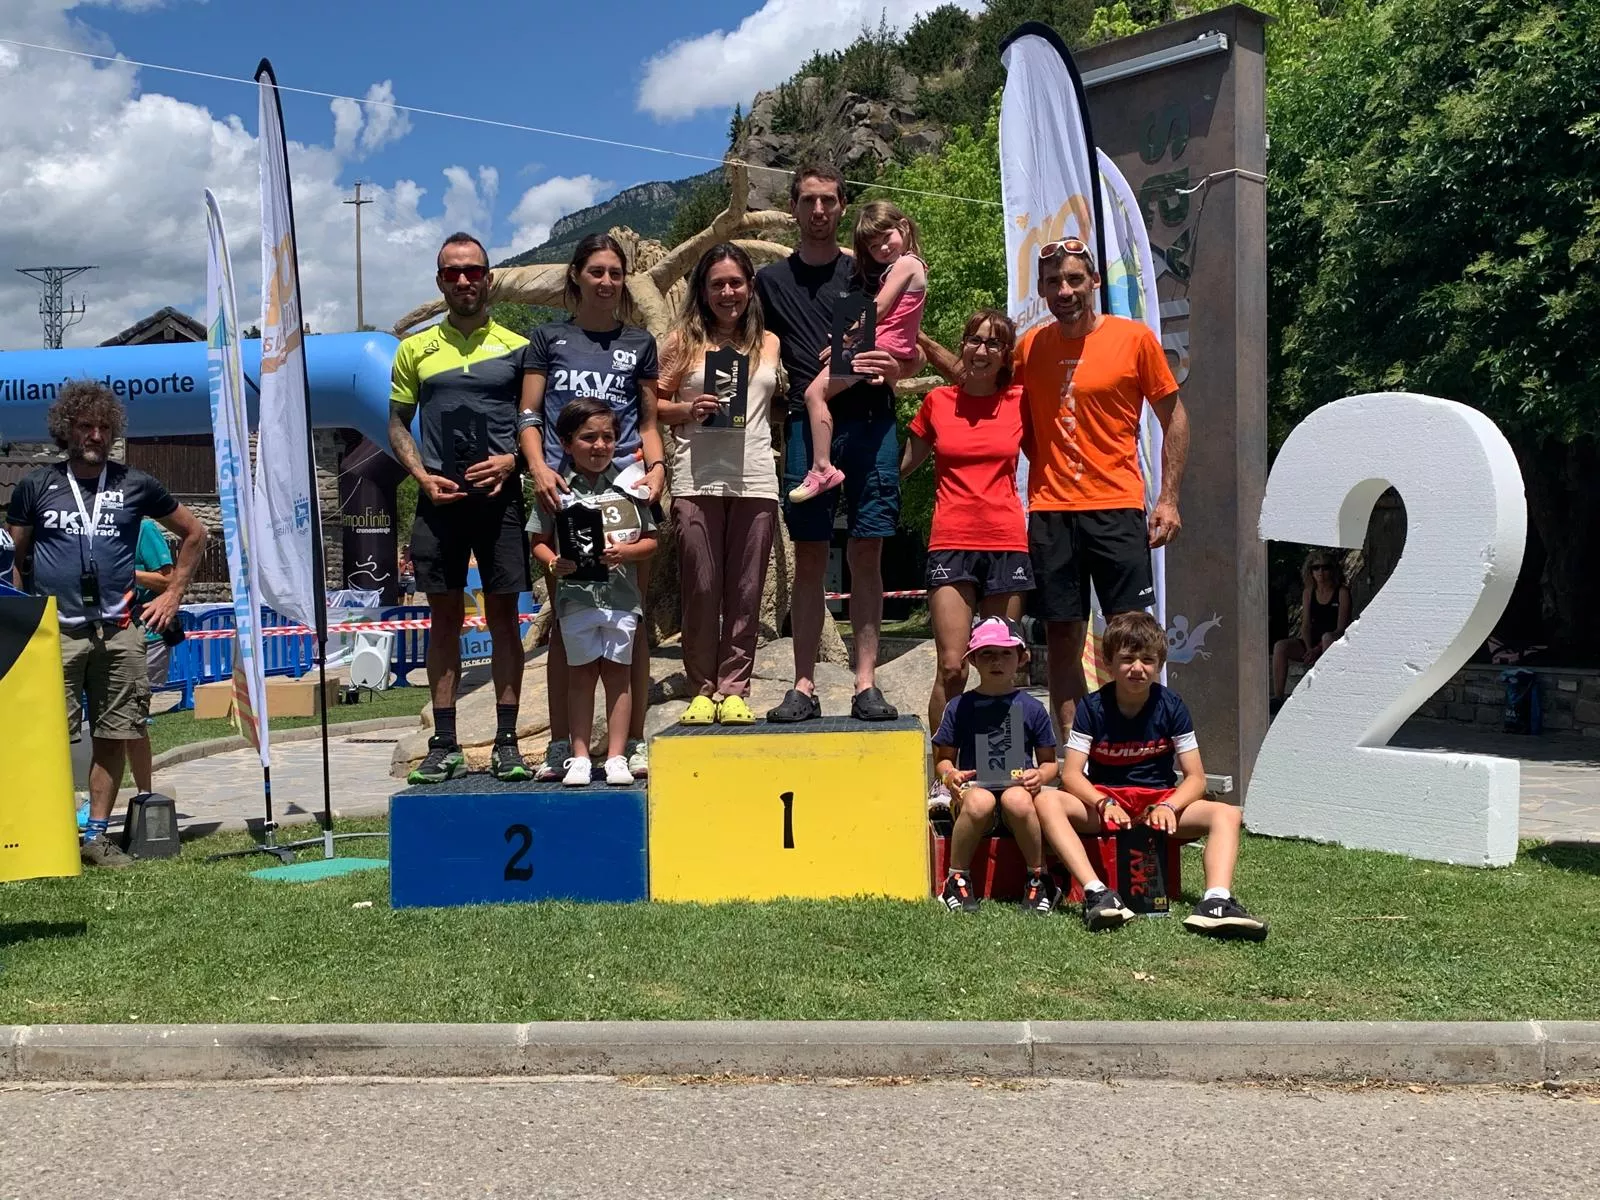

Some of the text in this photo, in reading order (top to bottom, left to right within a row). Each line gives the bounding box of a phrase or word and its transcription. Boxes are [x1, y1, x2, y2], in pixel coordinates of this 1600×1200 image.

[613, 349, 637, 365] on
[0, 372, 66, 401] illan
[554, 369, 615, 393] 2KV
[730, 360, 739, 398] Villanúa
[575, 388, 628, 404] collarada
[733, 415, 745, 423] on
[103, 489, 124, 503] on
[65, 525, 121, 537] collrada
[1244, 391, 1528, 869] 2
[779, 791, 795, 850] 1
[503, 823, 534, 881] 2
[1128, 847, 1148, 897] 2KV
